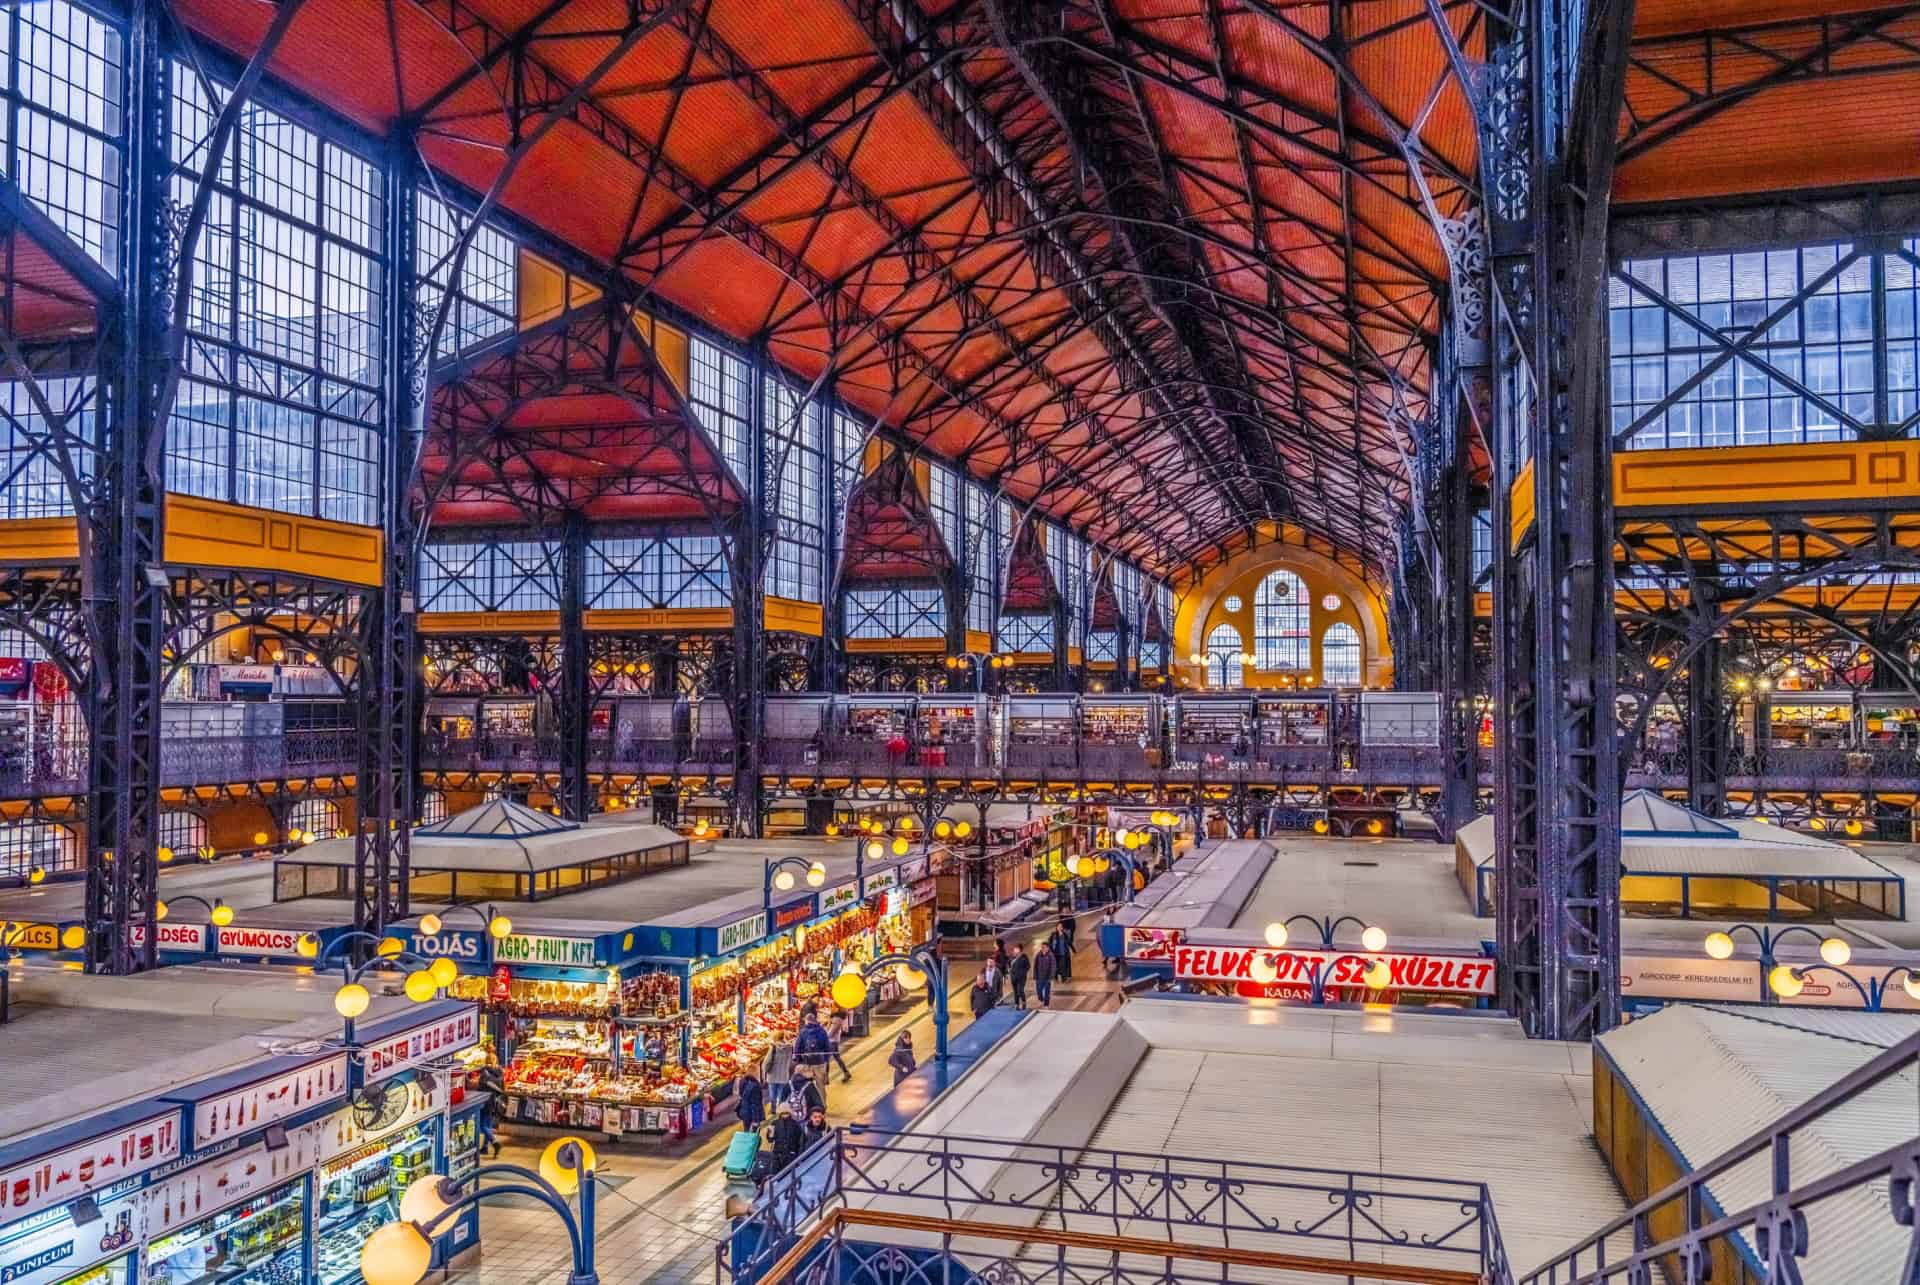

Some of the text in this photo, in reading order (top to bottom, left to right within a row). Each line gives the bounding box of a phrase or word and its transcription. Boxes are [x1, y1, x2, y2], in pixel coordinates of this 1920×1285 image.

[411, 931, 478, 957] TOJÁS
[496, 936, 595, 965] AGRO-FRUIT KFT.
[1176, 948, 1326, 980] FELVÁOTT
[1335, 955, 1493, 990] SZKÜZLET
[1263, 985, 1336, 1003] KABANS
[15, 1243, 74, 1275] UNICUM
